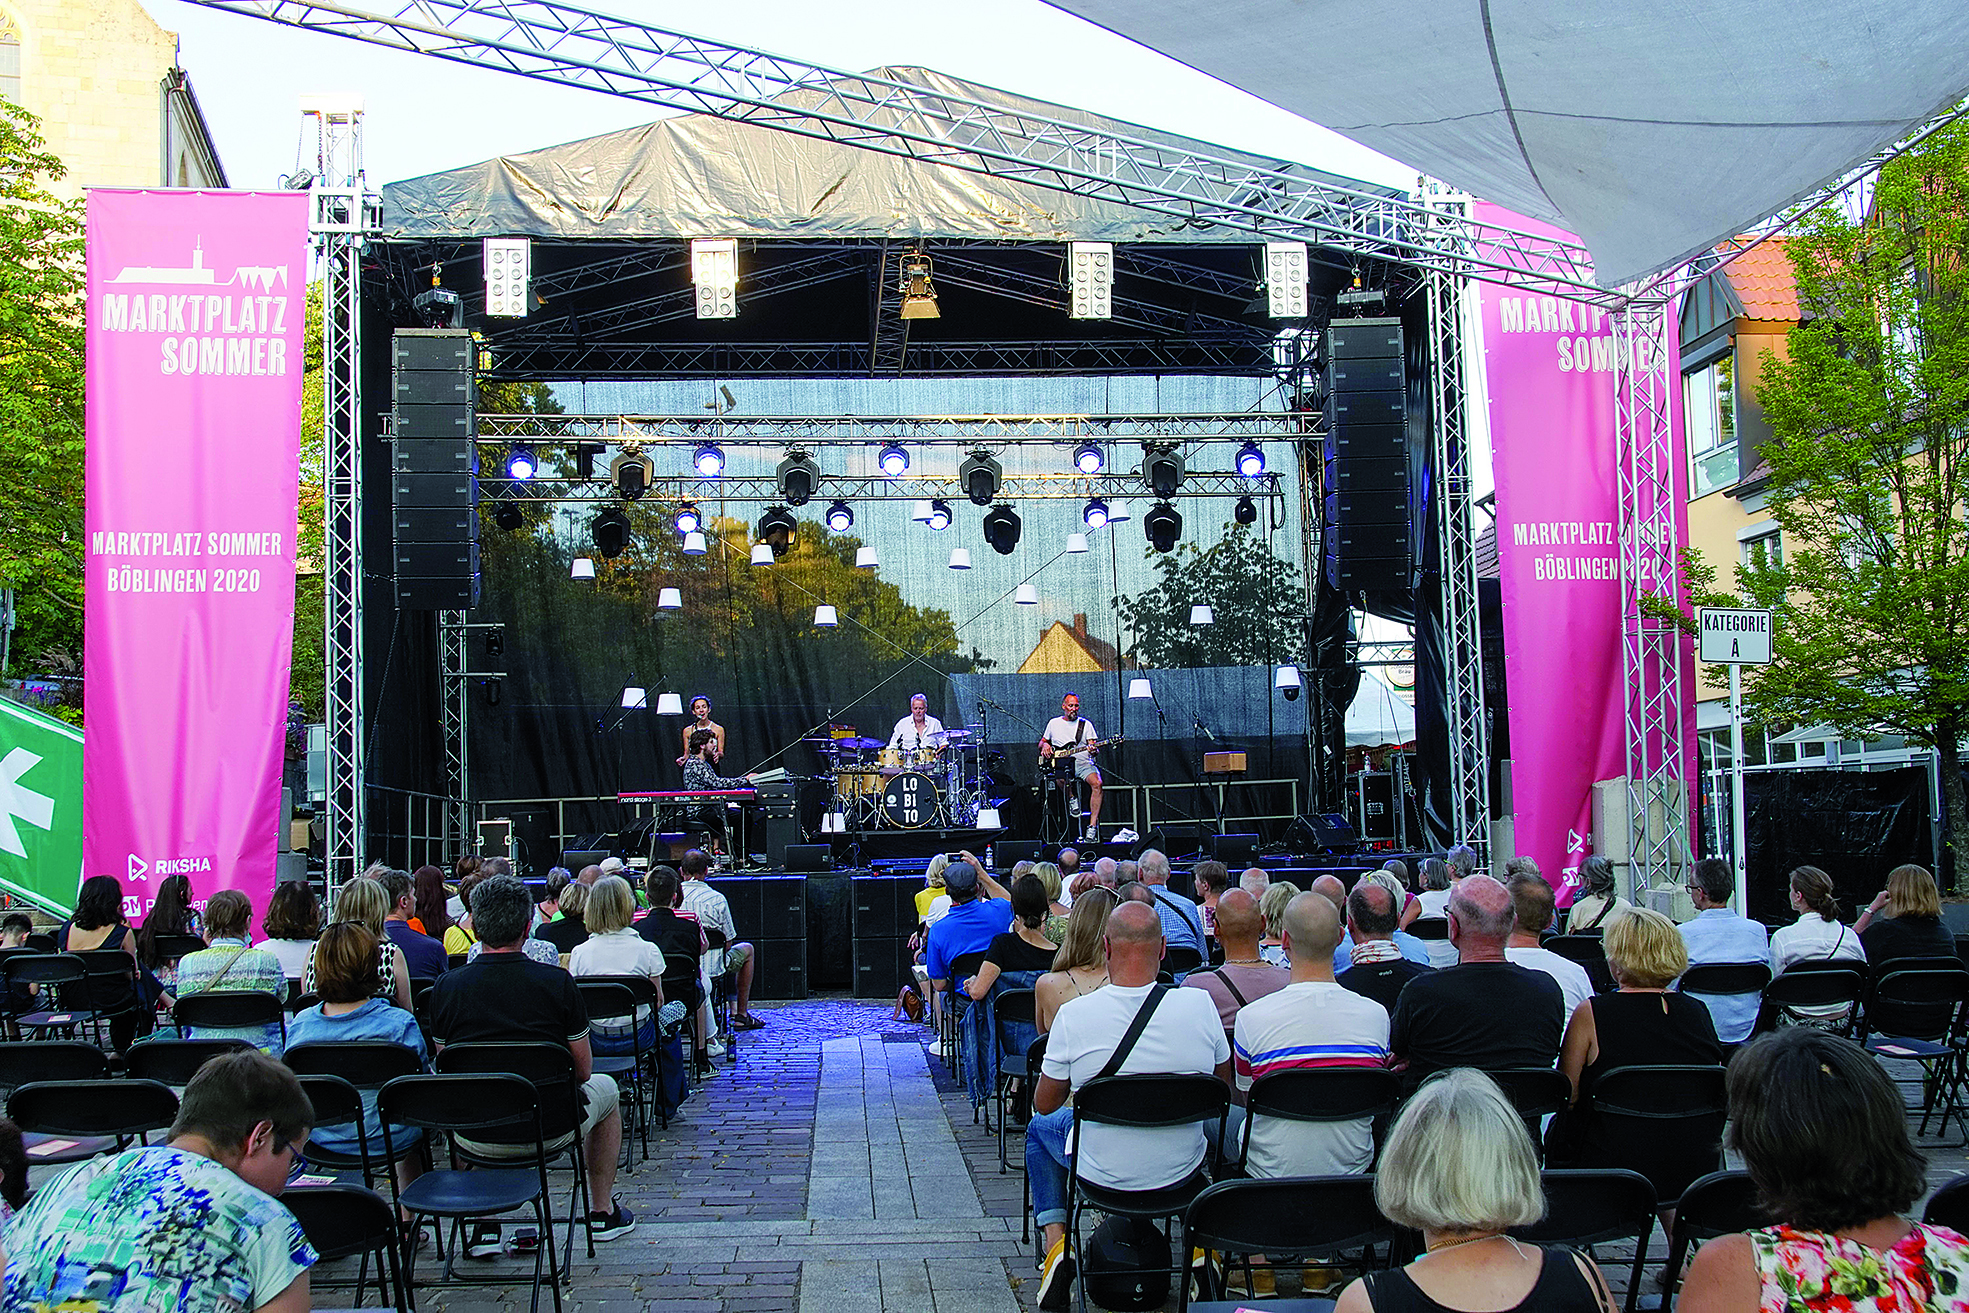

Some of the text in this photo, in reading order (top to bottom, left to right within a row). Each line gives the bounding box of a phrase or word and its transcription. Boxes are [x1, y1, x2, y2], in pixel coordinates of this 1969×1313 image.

[101, 293, 288, 335] MARKTPLATZ
[1499, 297, 1665, 334] MARKTP
[160, 336, 287, 376] SOMMER
[92, 531, 282, 556] MARKTPLATZ SOMMER
[1513, 521, 1678, 546] MARKTPLATZ OME
[107, 564, 261, 593] BÖBLINGEN 2020
[1534, 553, 1618, 581] BÖBLINGEN
[1704, 613, 1767, 633] KATEGORIE
[903, 777, 918, 791] LO
[904, 793, 917, 808] BI
[903, 809, 918, 823] TO
[155, 857, 212, 874] RIKSHA
